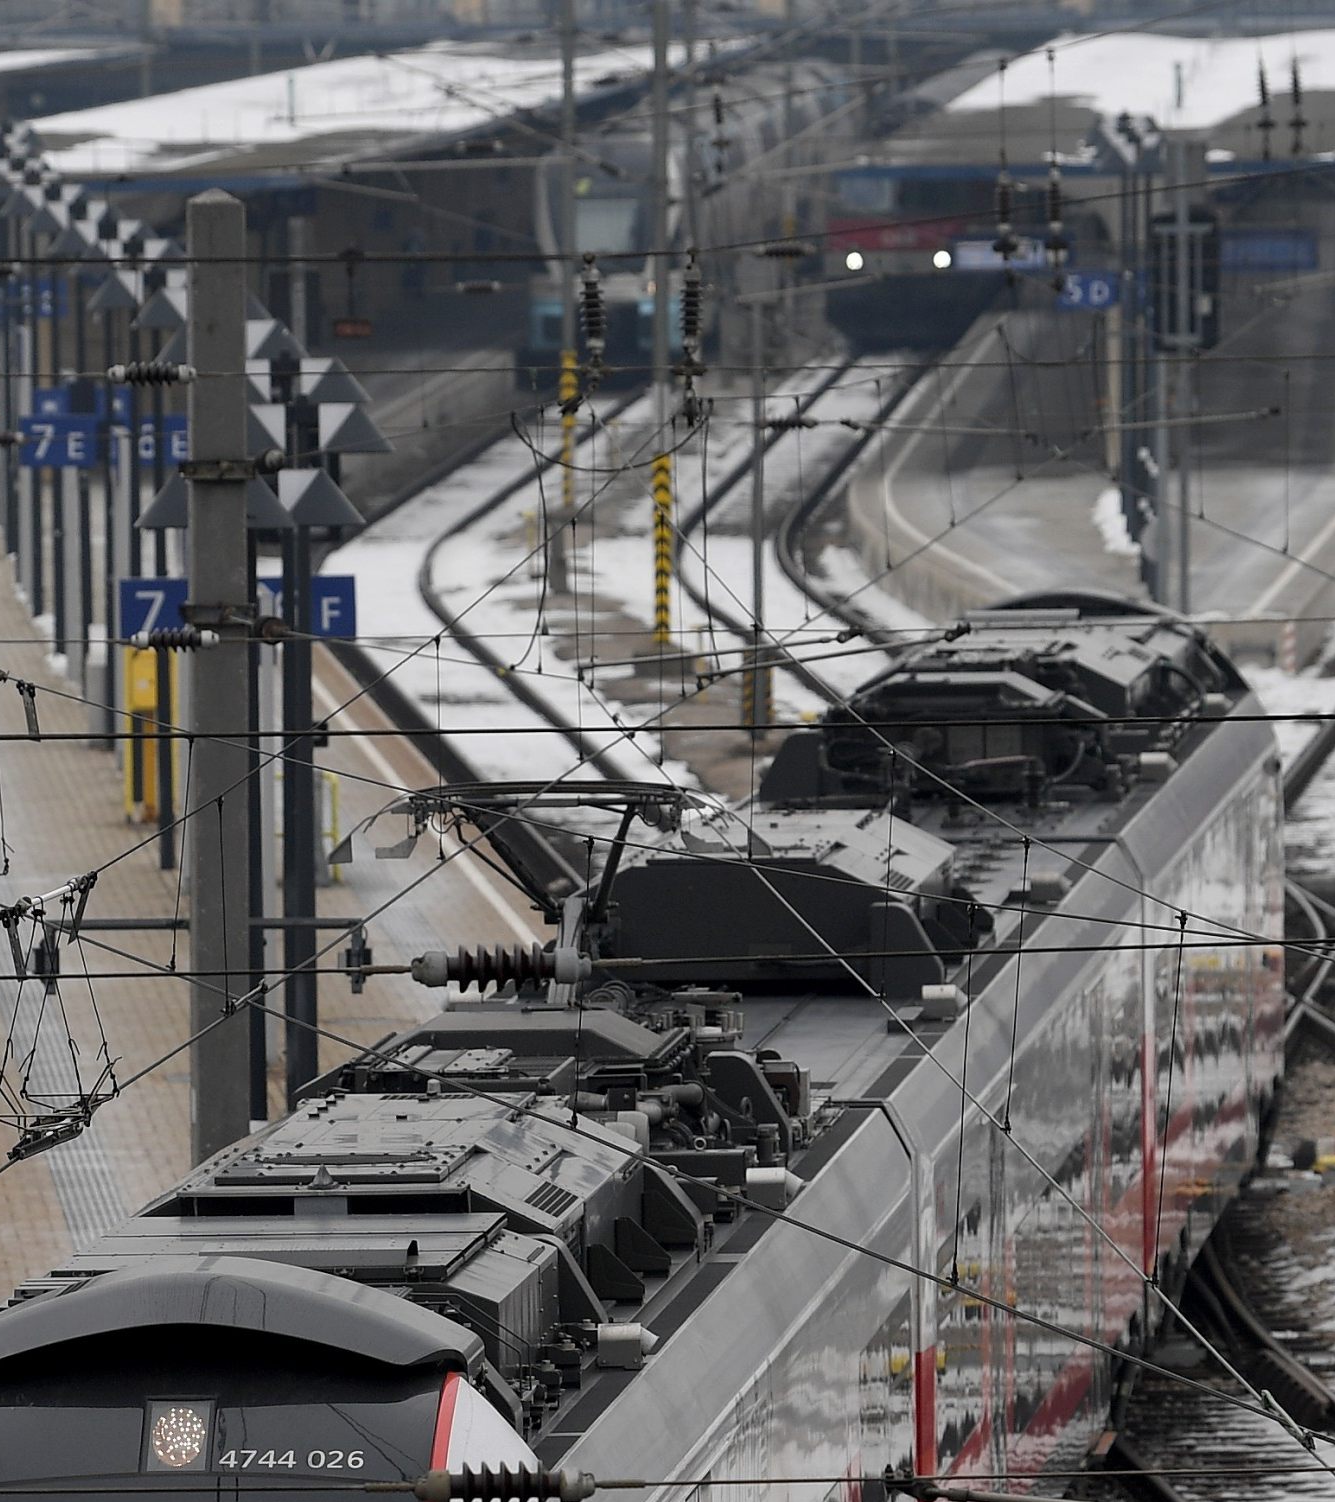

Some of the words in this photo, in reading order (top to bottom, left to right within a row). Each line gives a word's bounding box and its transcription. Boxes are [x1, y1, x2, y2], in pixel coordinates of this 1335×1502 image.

[1065, 274, 1083, 304] 5
[1089, 279, 1110, 304] D
[31, 424, 55, 460] 7
[67, 430, 86, 460] E
[135, 590, 165, 632] 7
[321, 597, 341, 631] F
[218, 1450, 297, 1468] 4744
[307, 1450, 364, 1469] 026
